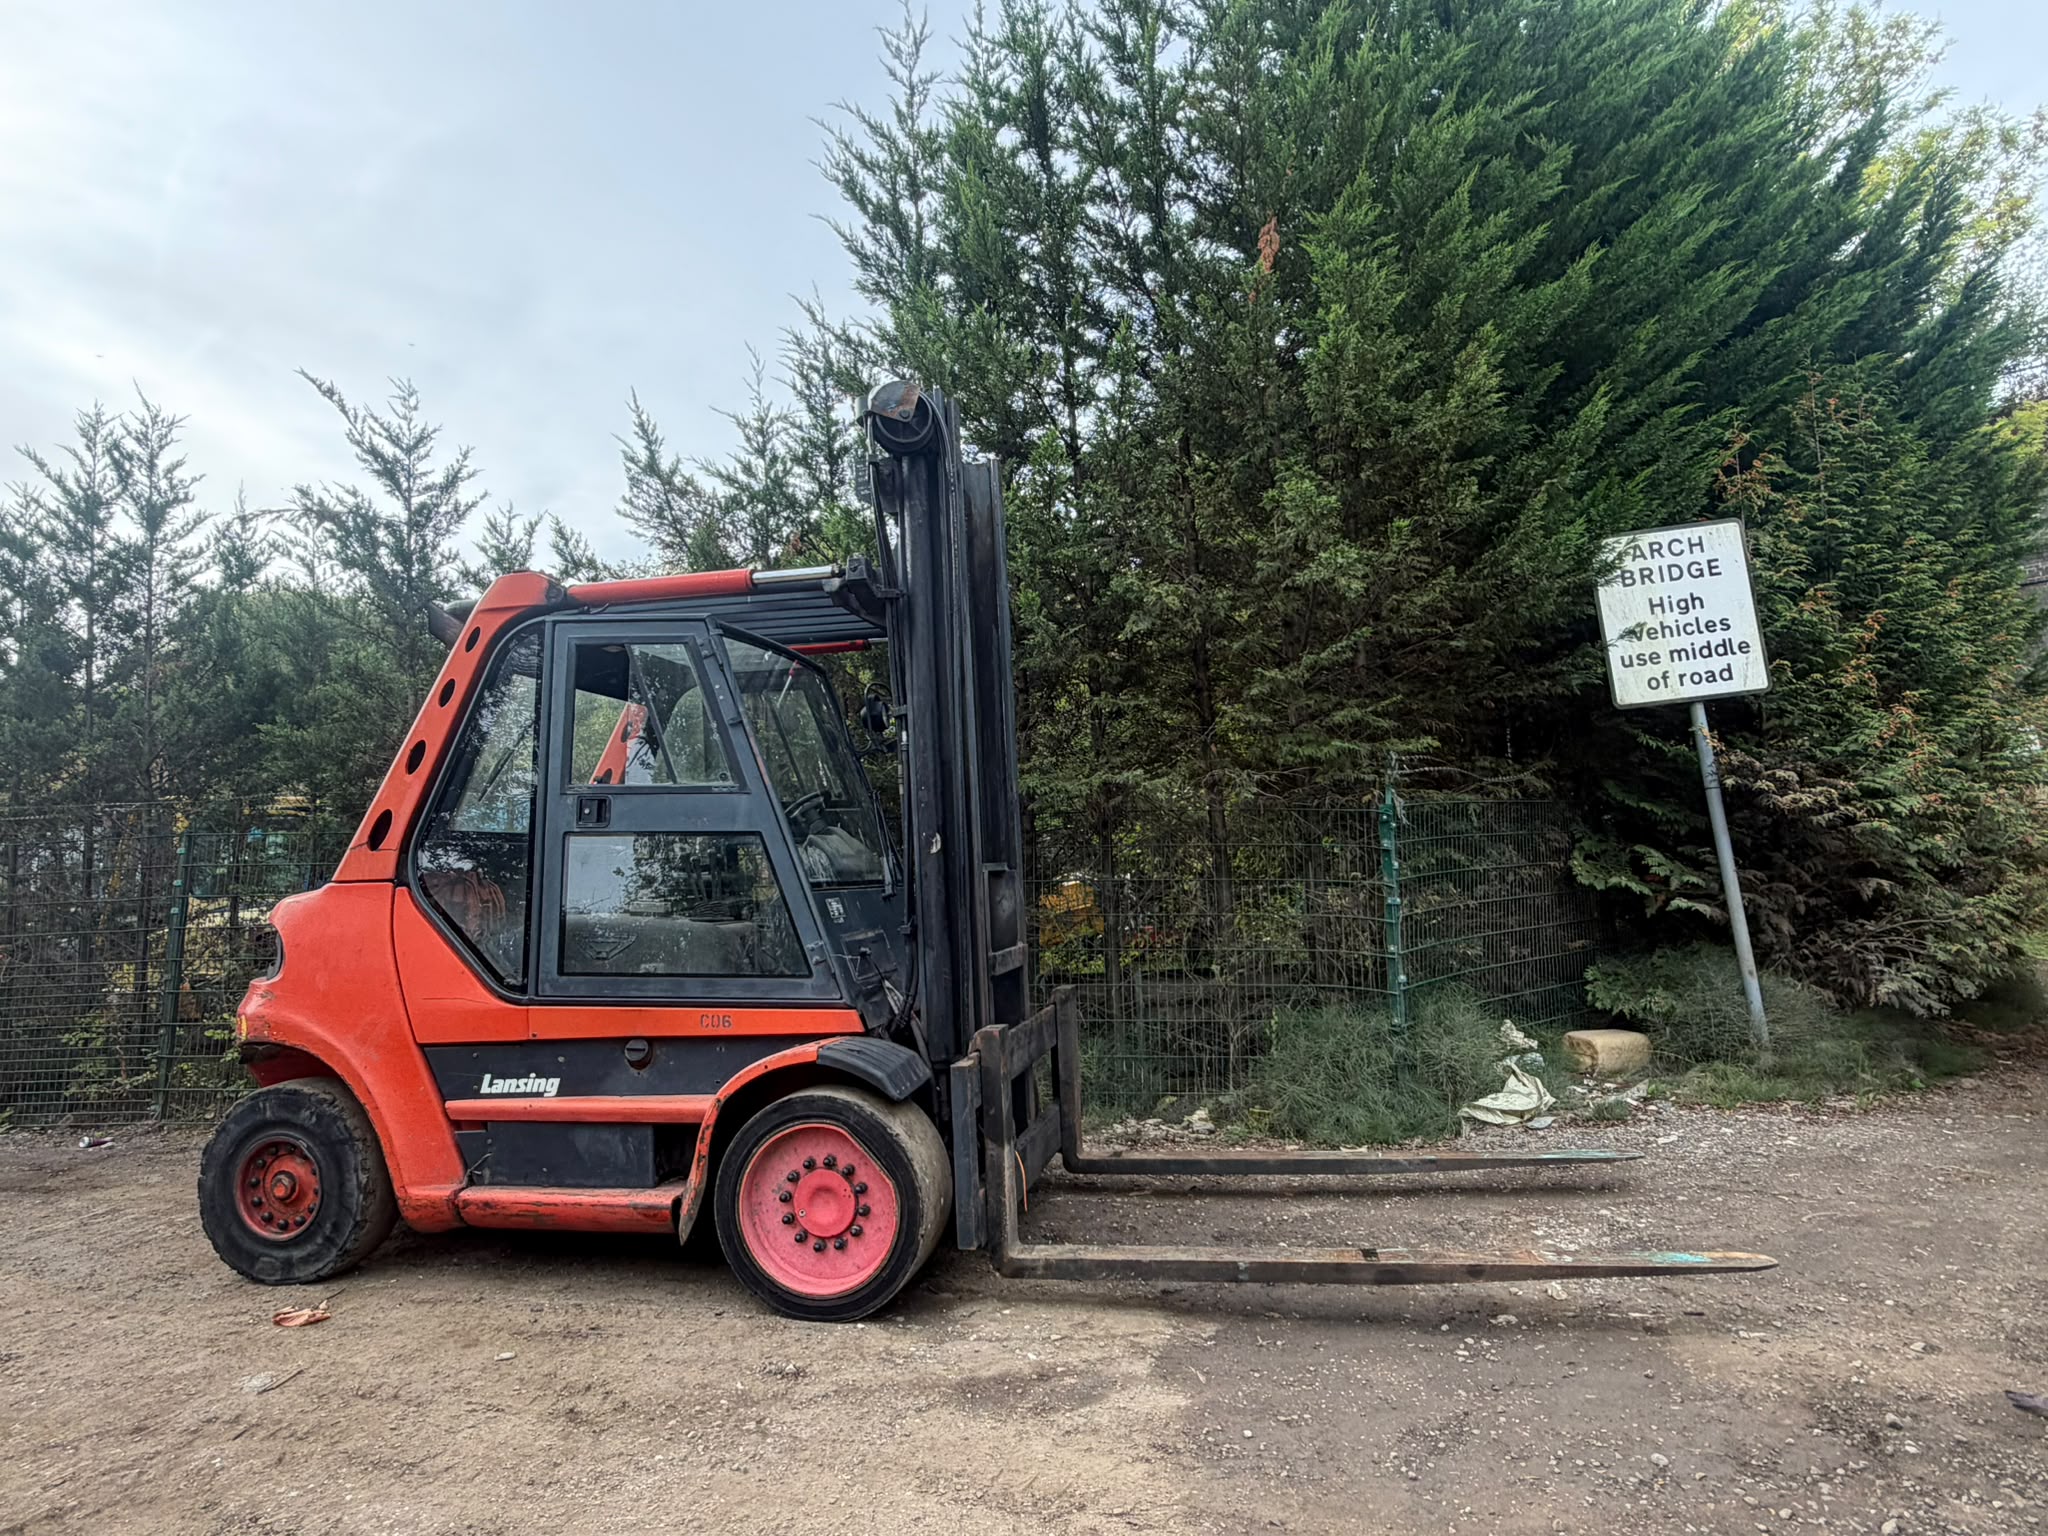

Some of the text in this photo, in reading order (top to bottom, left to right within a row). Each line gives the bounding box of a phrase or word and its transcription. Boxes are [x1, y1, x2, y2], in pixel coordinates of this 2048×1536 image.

[1631, 535, 1705, 562] ARCH
[1620, 558, 1722, 588] BRIDGE
[1648, 592, 1705, 615] High
[1632, 616, 1732, 642] vehicles
[1620, 637, 1751, 669] use middle
[1647, 663, 1734, 690] of road
[479, 1072, 561, 1097] Lansing
